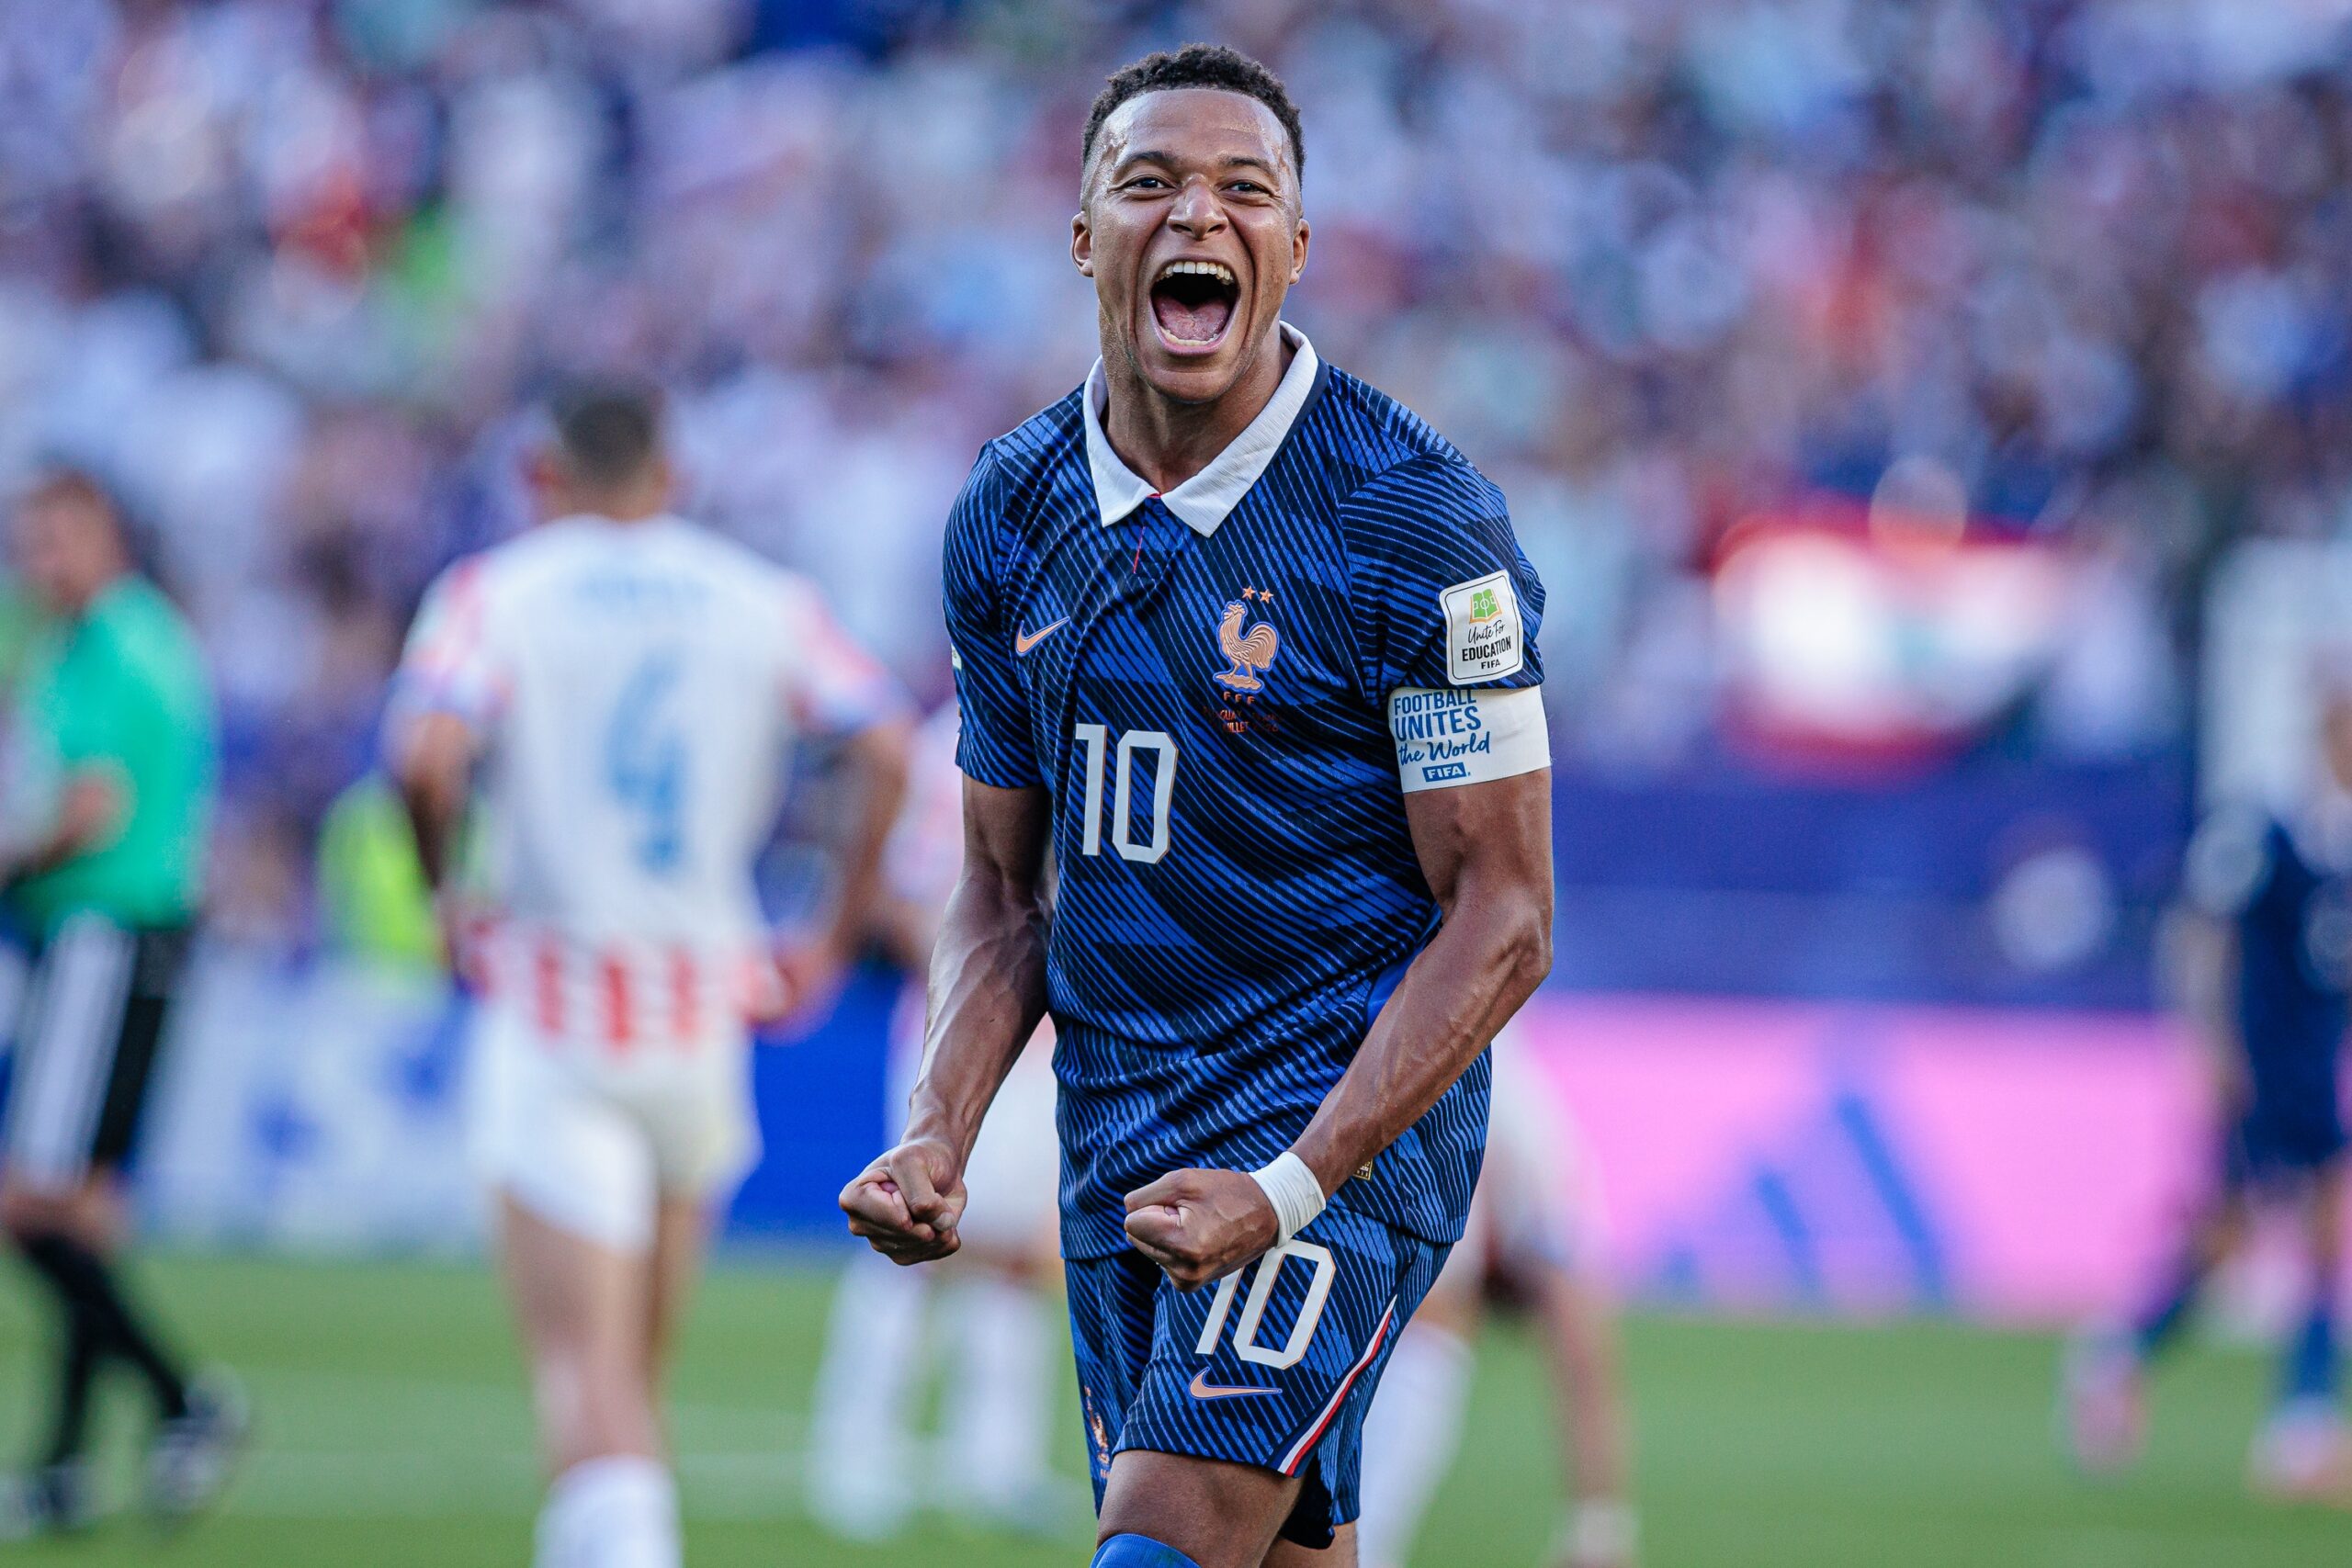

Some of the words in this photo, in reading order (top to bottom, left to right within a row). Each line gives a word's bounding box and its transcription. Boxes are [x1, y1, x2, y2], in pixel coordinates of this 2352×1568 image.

[1467, 625, 1494, 645] Unite
[1493, 619, 1505, 637] For
[1462, 635, 1511, 661] EDUCATION
[1481, 659, 1500, 670] FIFA
[1394, 689, 1476, 716] FOOTBALL
[1395, 705, 1482, 742] UNITES
[1398, 742, 1425, 766] the
[1427, 730, 1490, 761] World
[1426, 765, 1464, 779] FIFA
[1075, 723, 1179, 864] 10
[1195, 1239, 1337, 1371] 10
